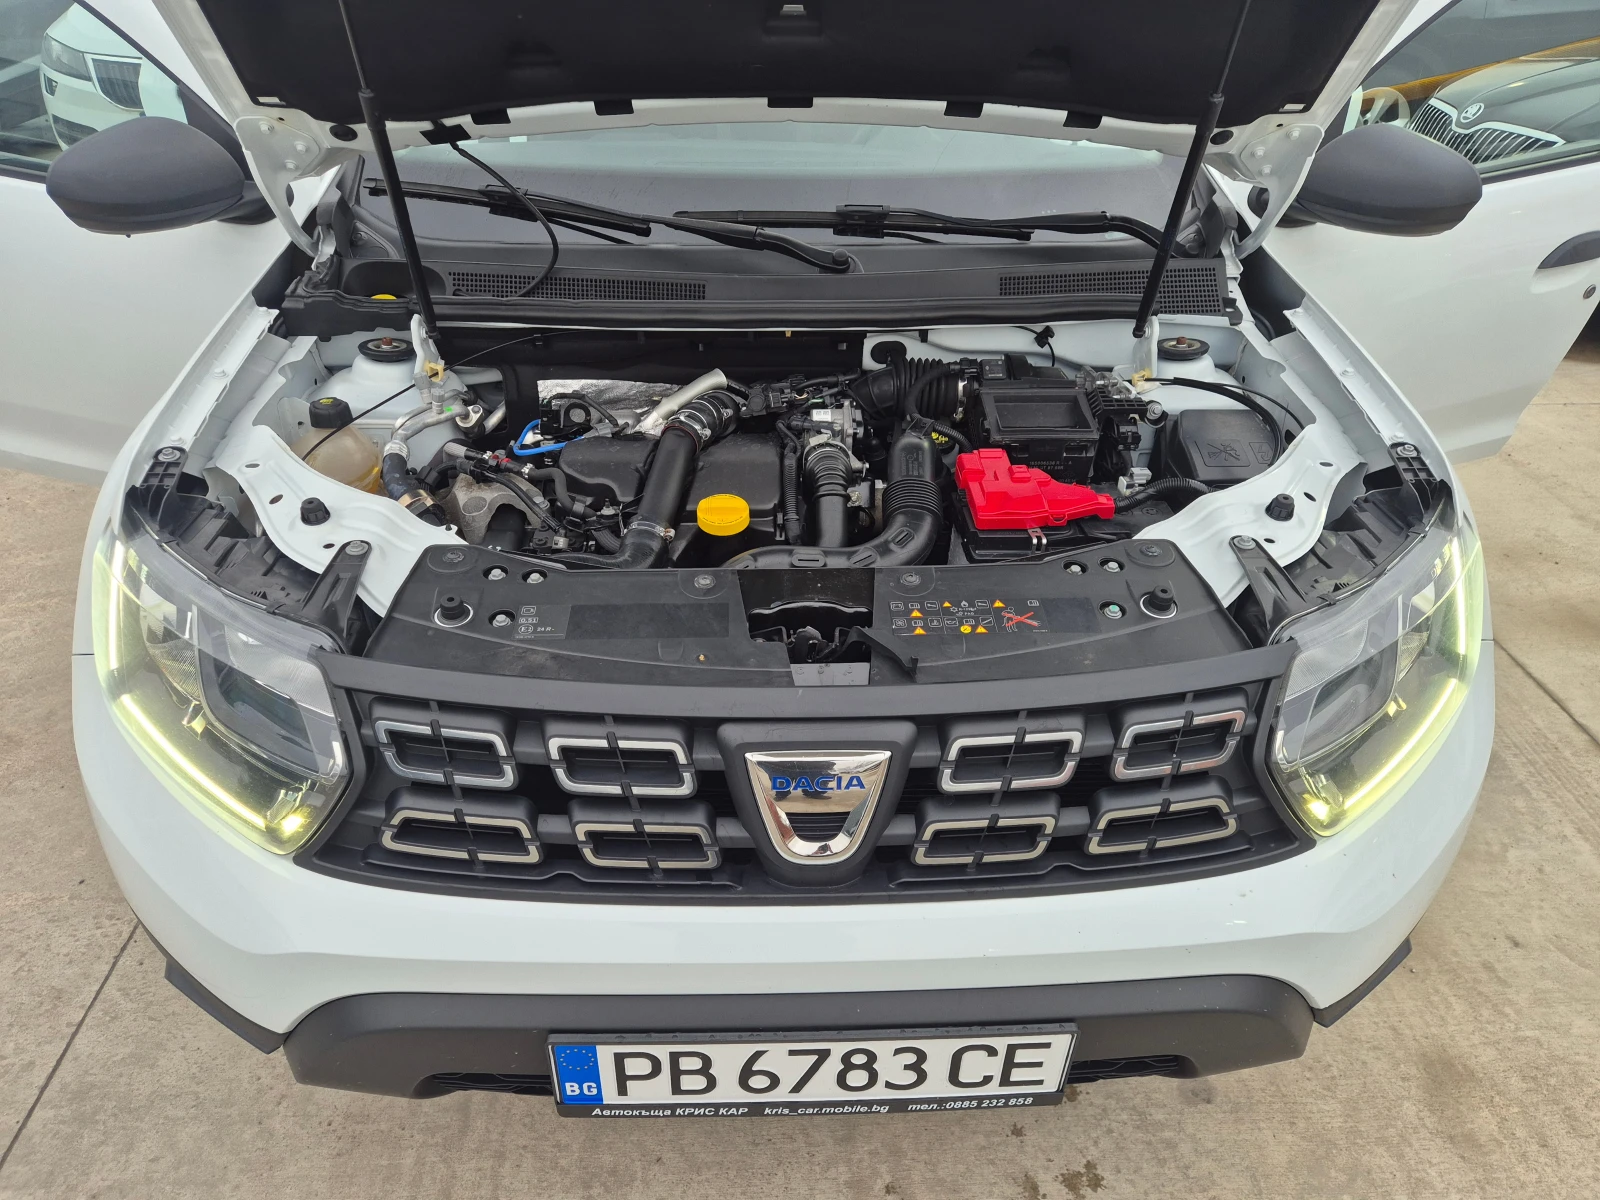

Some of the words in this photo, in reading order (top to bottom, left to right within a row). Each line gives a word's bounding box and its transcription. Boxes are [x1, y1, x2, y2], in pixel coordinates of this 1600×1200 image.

[771, 775, 866, 791] DACIA
[613, 1050, 718, 1097] PB
[737, 1046, 928, 1095] 6783
[948, 1041, 1052, 1089] CE
[565, 1082, 598, 1096] BG
[980, 1099, 1005, 1108] 232
[1008, 1097, 1034, 1106] 858
[591, 1106, 672, 1117] Автокъща
[675, 1107, 716, 1116] КРИС
[718, 1106, 749, 1116] КАР
[763, 1103, 890, 1116] kris_car.mobile.bg
